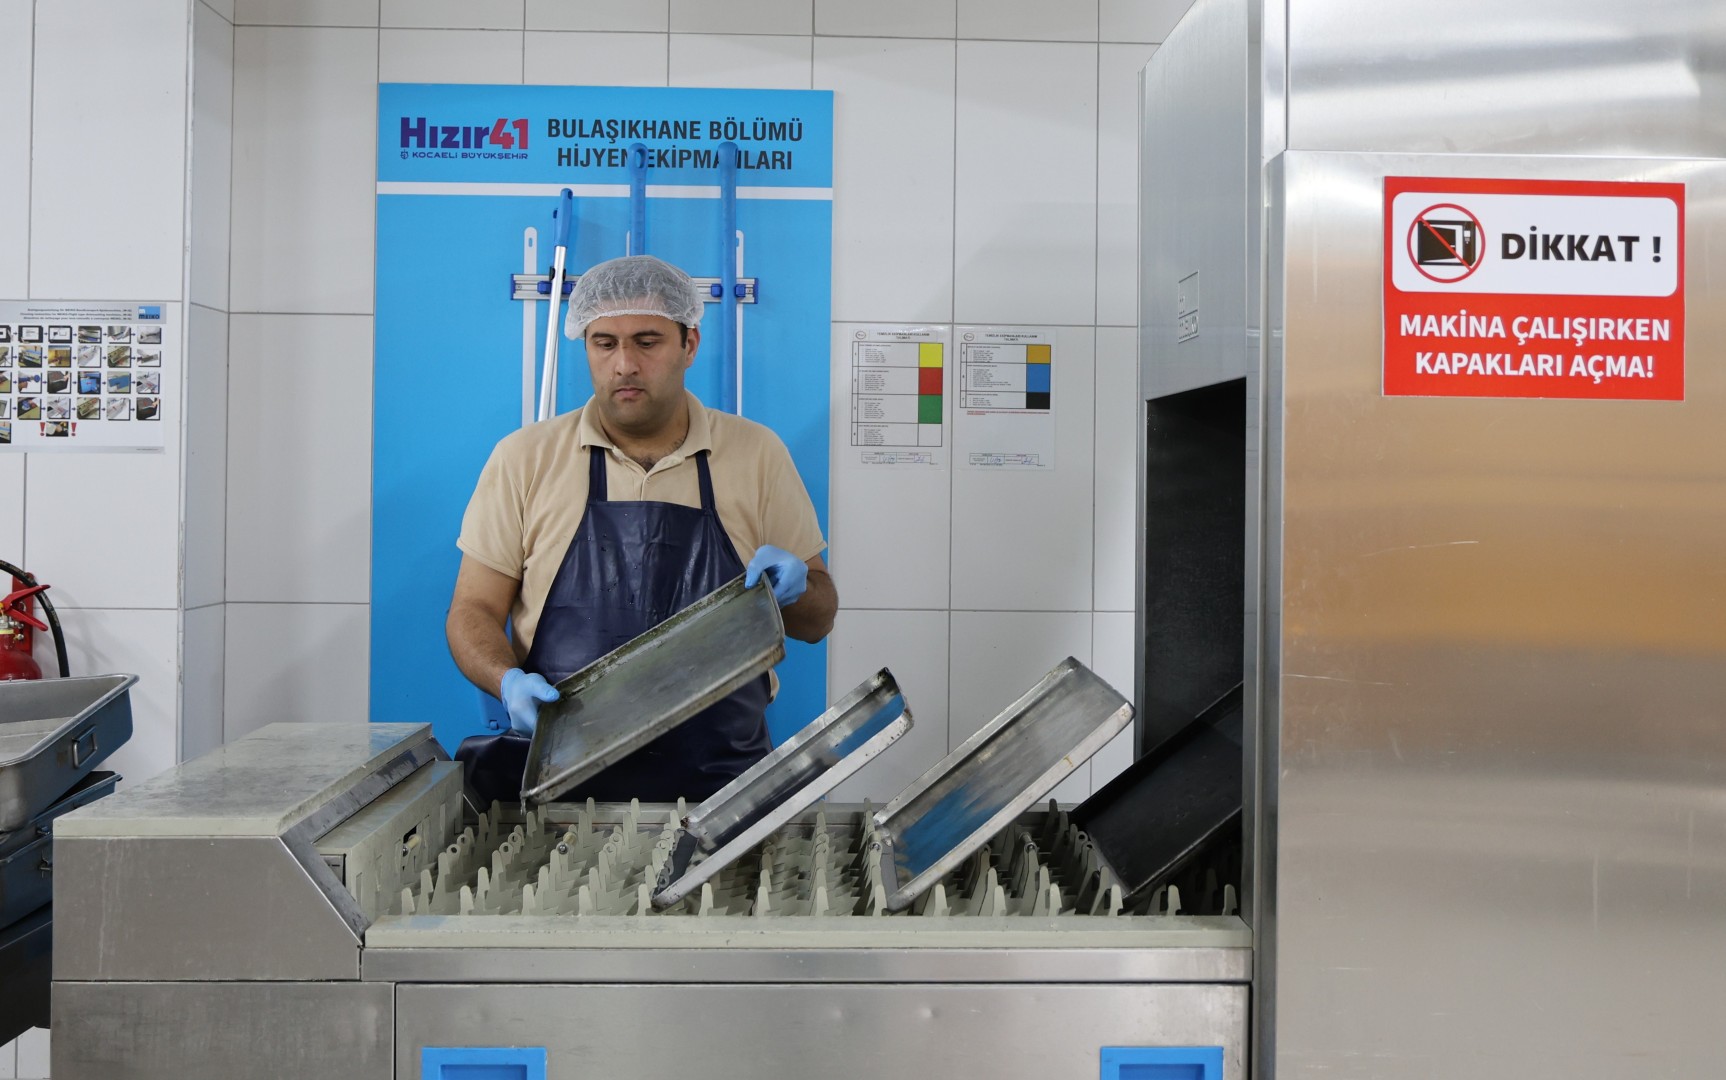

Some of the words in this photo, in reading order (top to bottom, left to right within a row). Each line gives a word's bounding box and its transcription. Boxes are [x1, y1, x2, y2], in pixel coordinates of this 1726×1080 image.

[400, 117, 529, 150] Hızır41
[547, 118, 701, 144] BULAŞIKHANE
[709, 117, 803, 141] BÖLÜMÜ
[412, 151, 458, 159] KOCAELİ
[461, 151, 528, 160] BÜYÜKŞEHİR
[1501, 226, 1640, 262] DİKKAT
[1653, 236, 1662, 263] !
[1400, 309, 1506, 338] MAKİNA
[1512, 315, 1670, 346] ÇALIŞIRKEN
[1415, 352, 1563, 377] KAPAKLARI
[1569, 355, 1654, 384] AÇMA!
